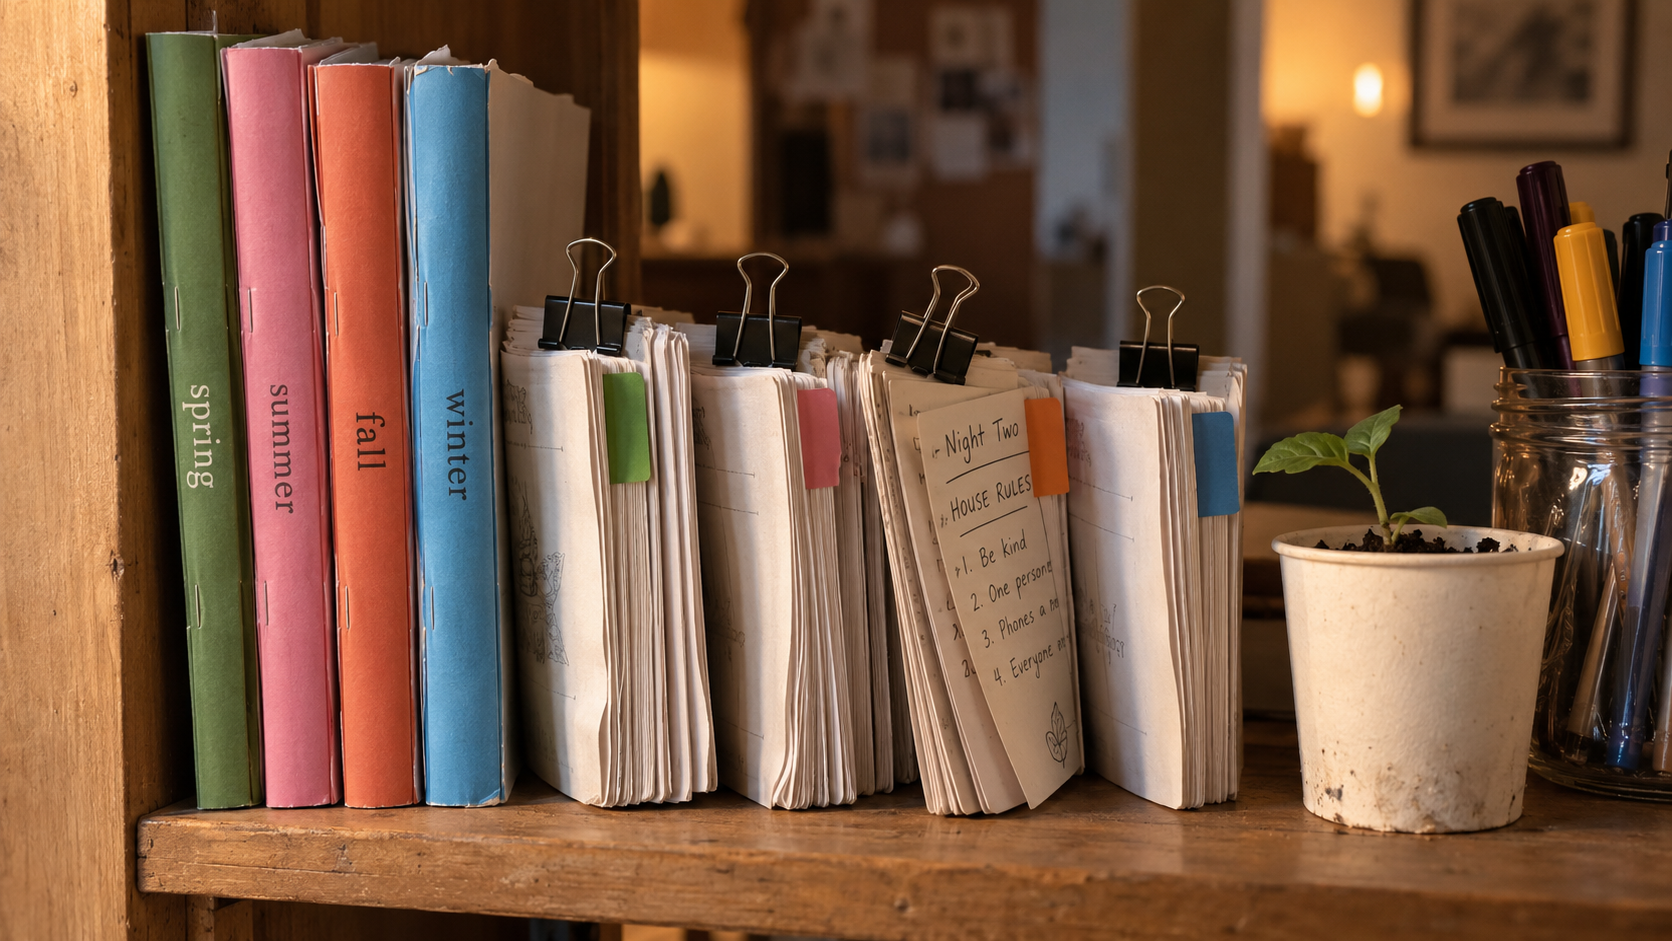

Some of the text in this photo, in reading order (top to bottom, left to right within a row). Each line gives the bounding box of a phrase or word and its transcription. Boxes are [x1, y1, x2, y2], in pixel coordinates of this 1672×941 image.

[182, 384, 221, 489] spring
[269, 383, 294, 514] summer
[355, 411, 387, 472] fall
[445, 388, 473, 501] winter
[944, 422, 985, 464] Night
[992, 417, 1019, 442] Two
[950, 489, 990, 522] HOUSE
[996, 473, 1032, 502] RULES
[979, 546, 996, 568] Be
[1000, 528, 1028, 559] kind
[970, 592, 984, 612] 2.
[988, 583, 1010, 604] One
[981, 629, 994, 649] 3.
[998, 609, 1035, 640] Phones
[993, 666, 1006, 686] 4.
[1009, 643, 1054, 679] Everyone
